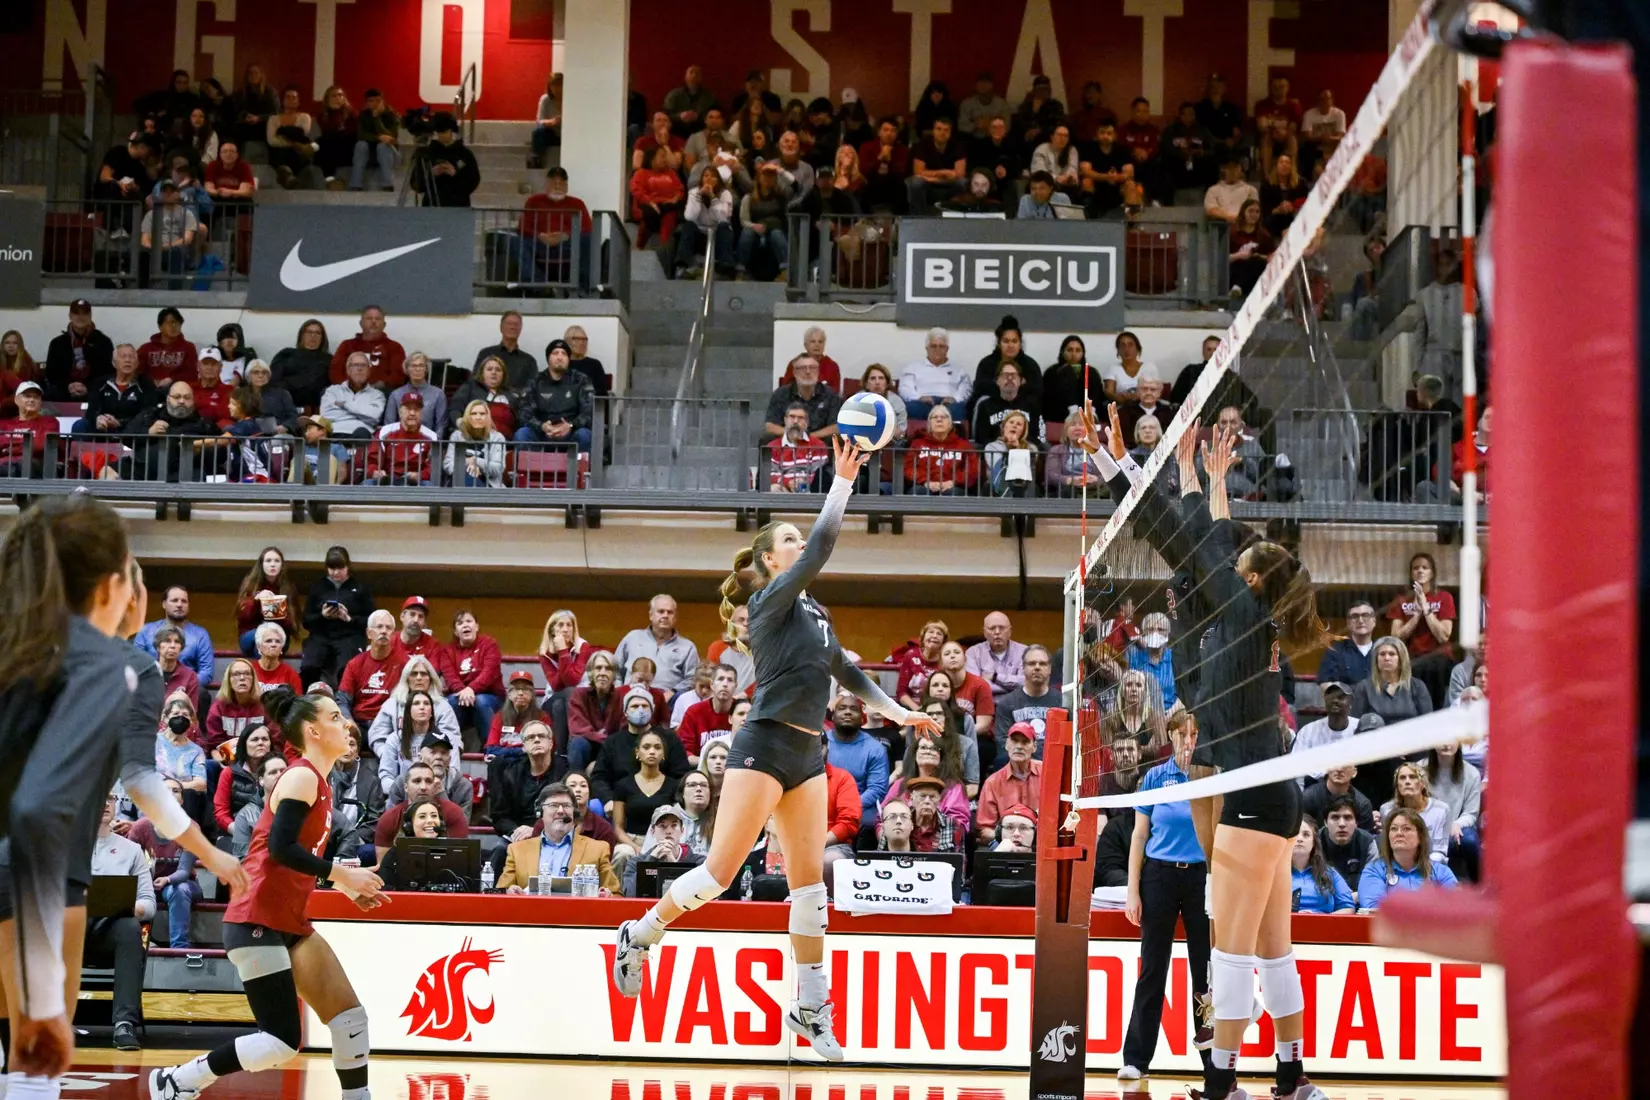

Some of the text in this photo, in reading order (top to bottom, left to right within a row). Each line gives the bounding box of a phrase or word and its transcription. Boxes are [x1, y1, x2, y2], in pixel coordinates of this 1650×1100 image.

[770, 0, 1300, 116] STATE
[816, 619, 829, 648] 7
[854, 893, 929, 905] GATORADE
